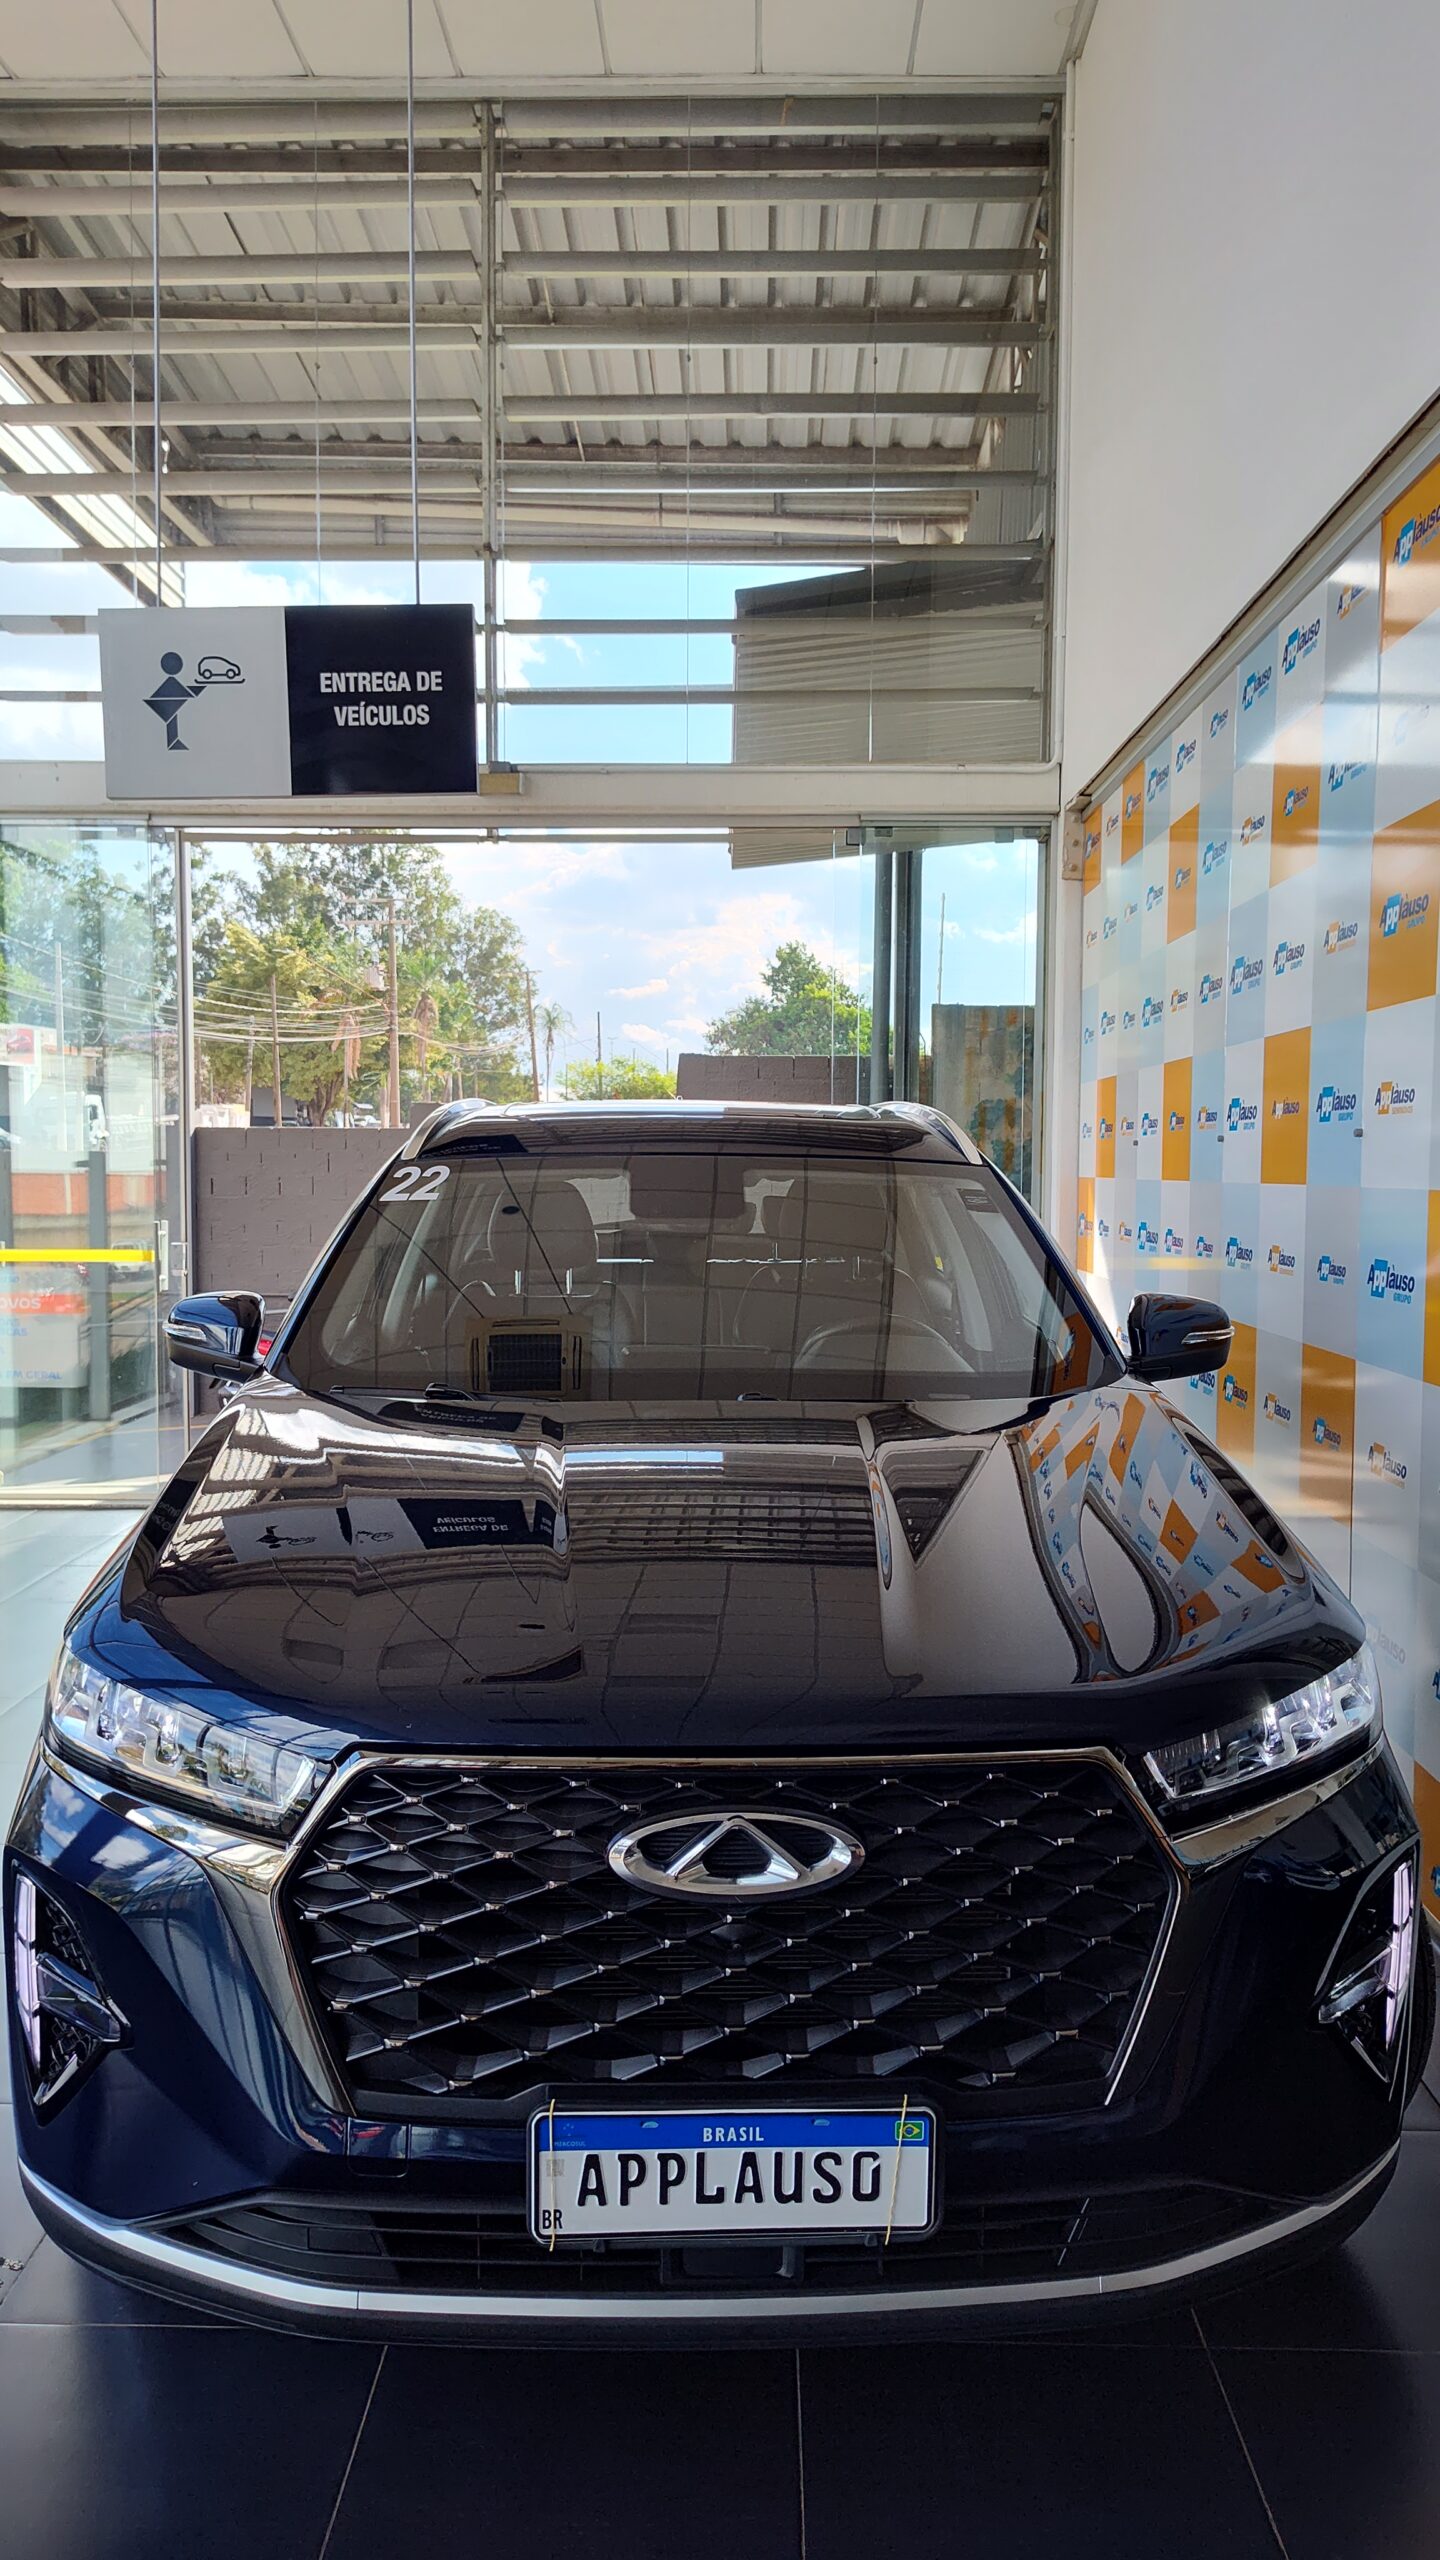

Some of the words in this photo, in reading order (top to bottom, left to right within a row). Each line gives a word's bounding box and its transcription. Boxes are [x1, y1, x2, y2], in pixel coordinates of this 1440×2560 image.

[319, 671, 411, 693] ENTREGA
[417, 670, 443, 691] DE
[334, 700, 430, 727] VEÍCULOS
[379, 1165, 451, 1201] 22
[703, 2126, 765, 2143] BRASIL
[576, 2151, 882, 2207] APPLAUSO
[542, 2209, 563, 2230] BR
